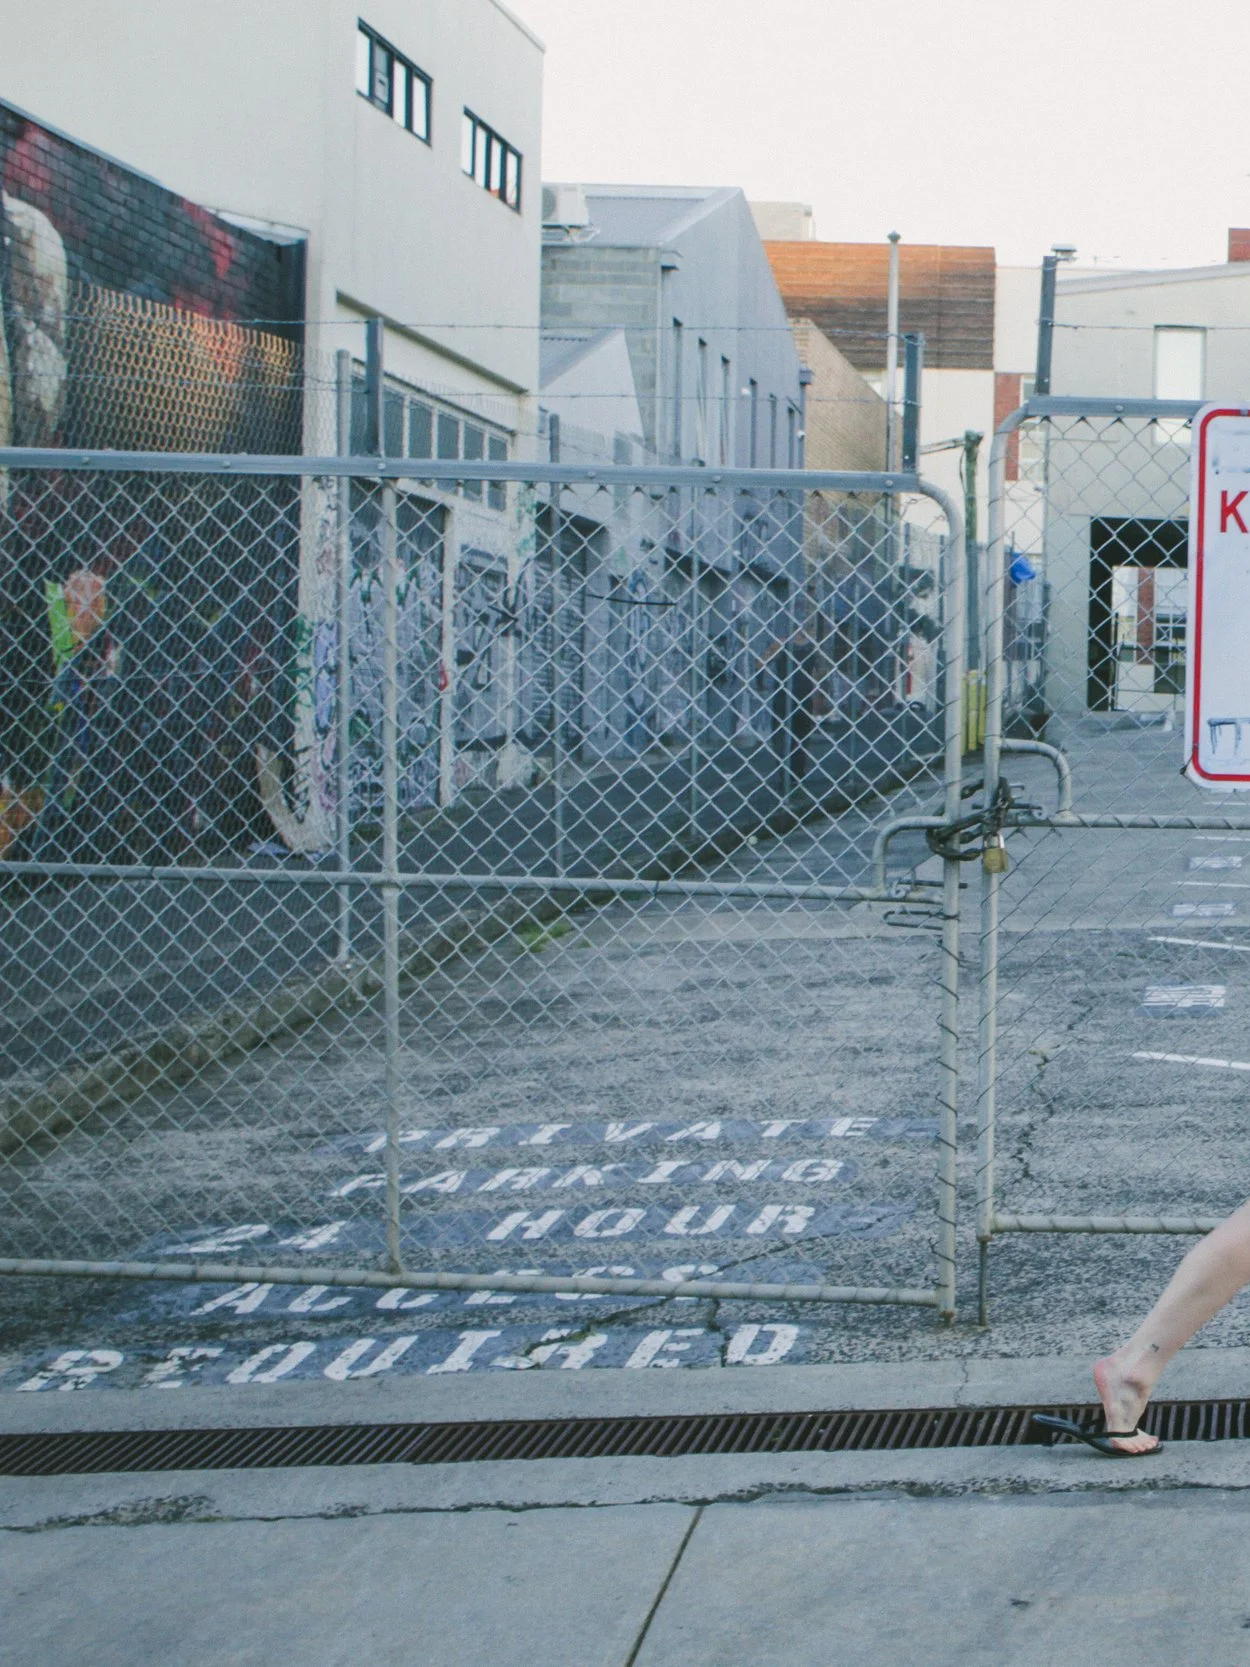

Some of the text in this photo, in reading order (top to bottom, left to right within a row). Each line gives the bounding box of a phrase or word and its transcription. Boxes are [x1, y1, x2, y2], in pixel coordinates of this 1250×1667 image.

[363, 1116, 879, 1153] PRIVATE
[330, 1158, 845, 1197] PARKING
[486, 1204, 816, 1241] HOUR
